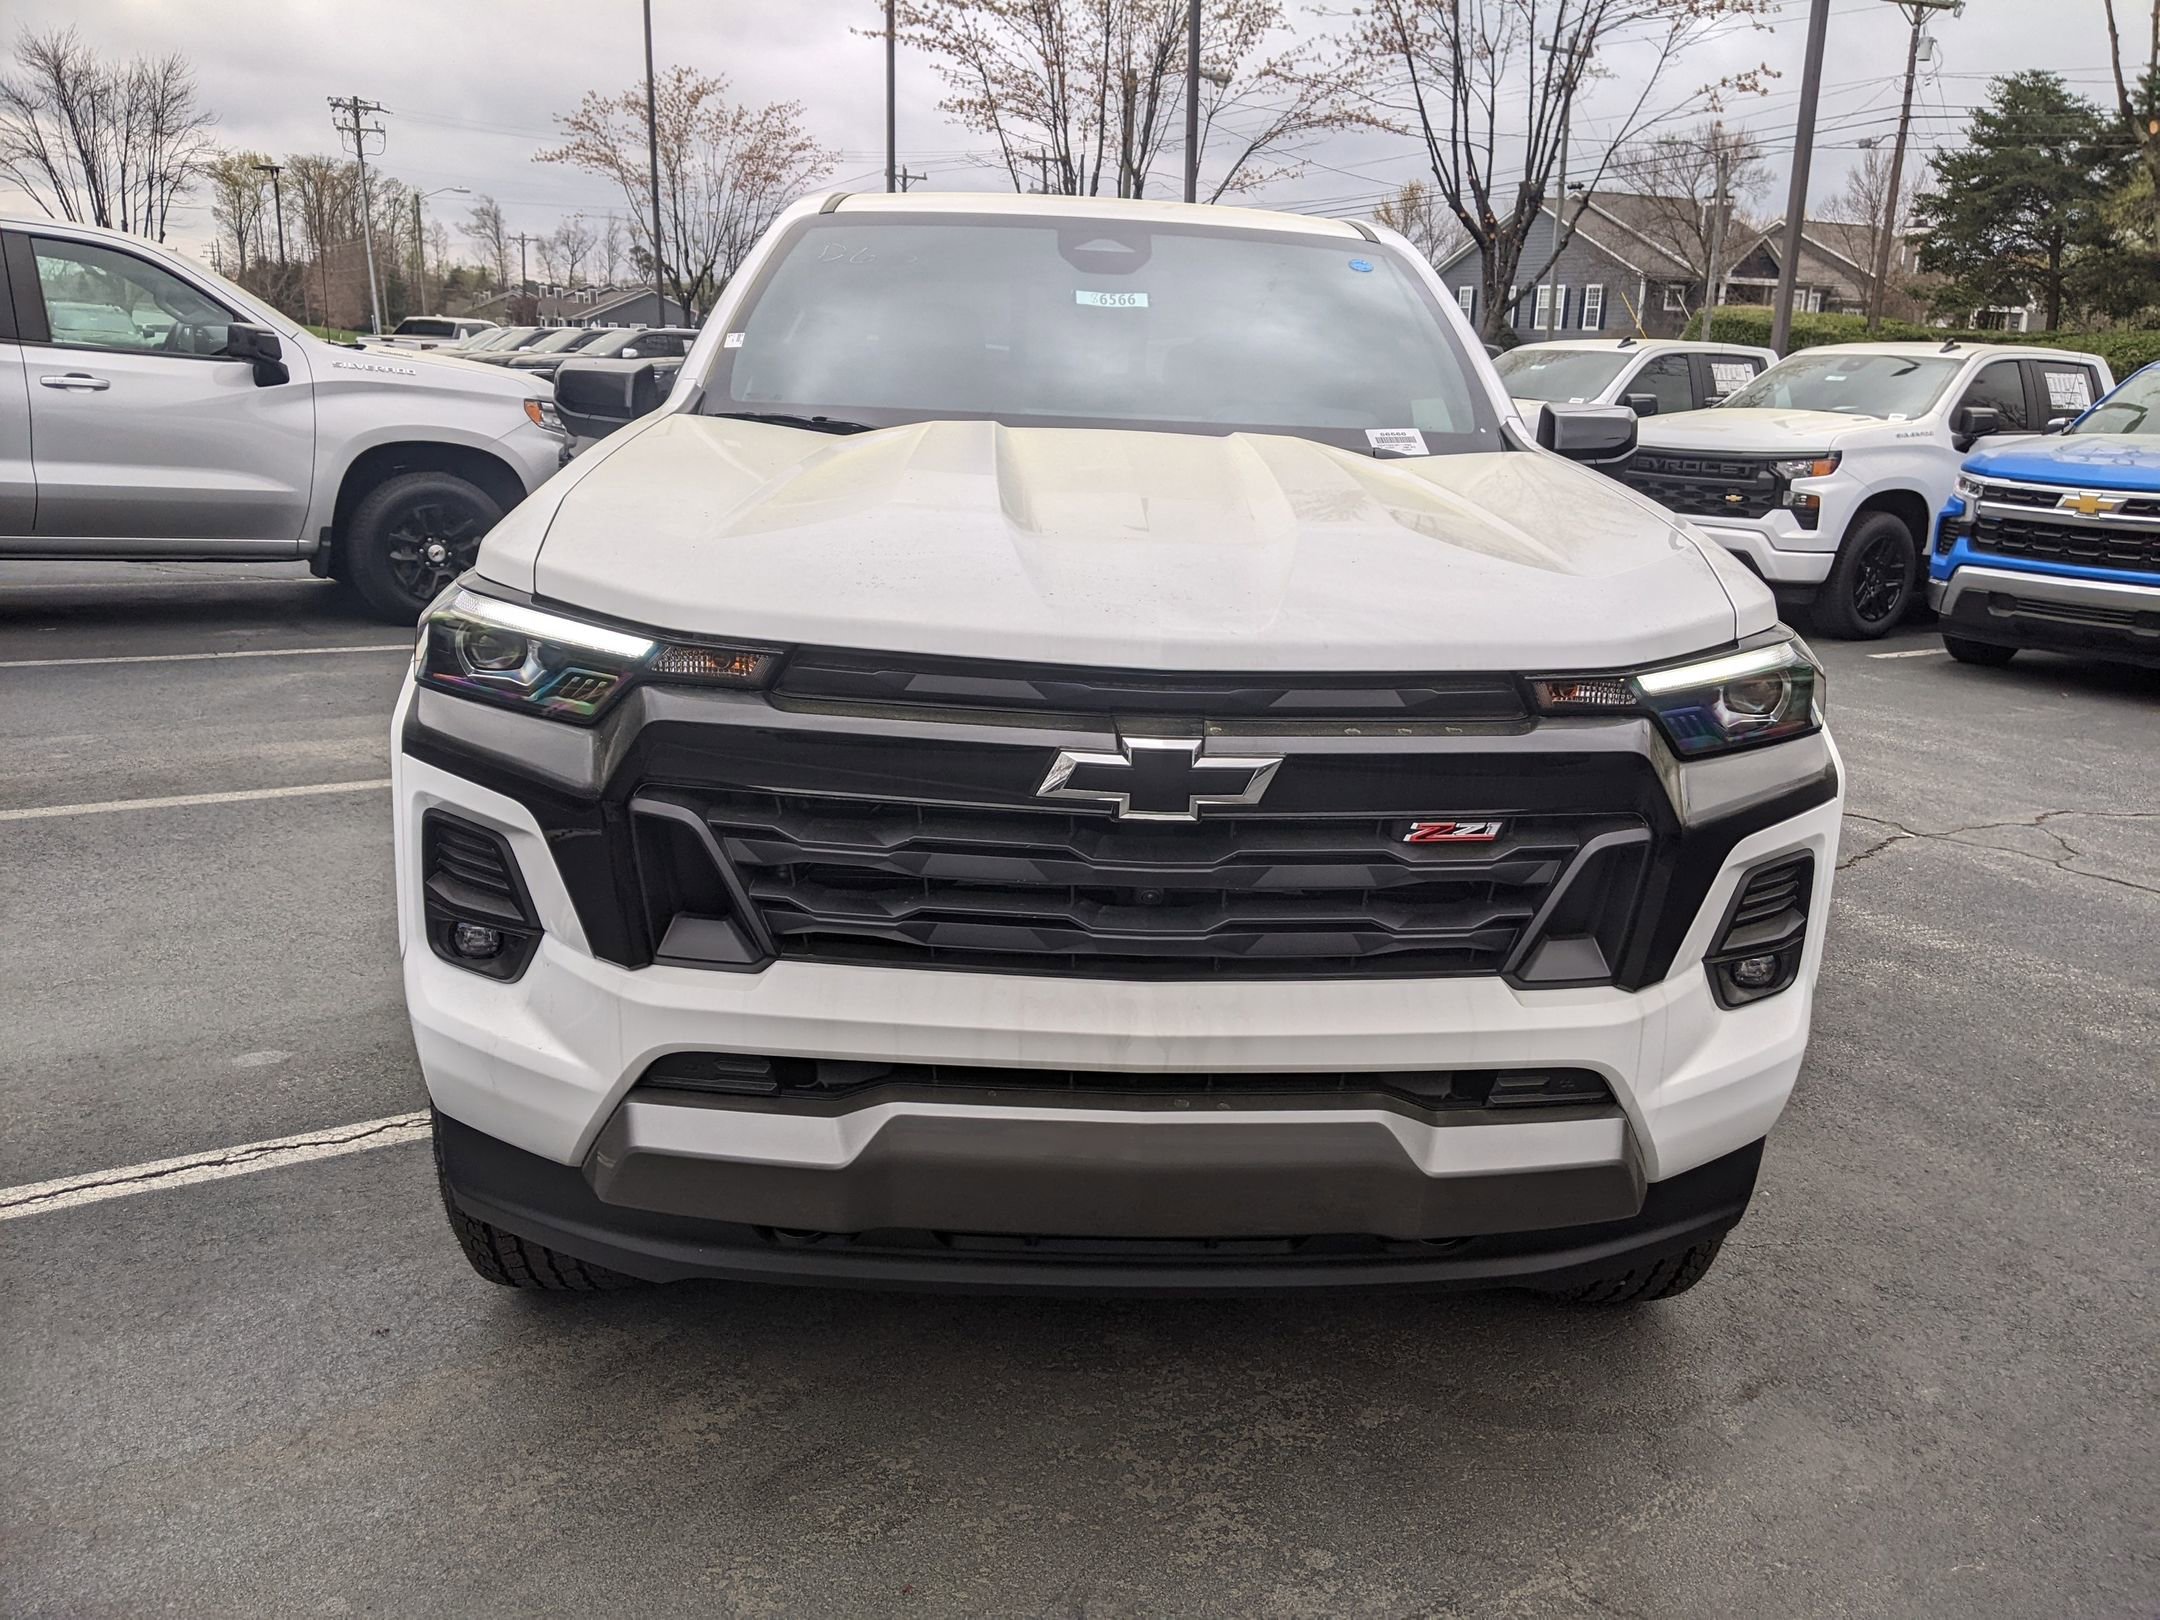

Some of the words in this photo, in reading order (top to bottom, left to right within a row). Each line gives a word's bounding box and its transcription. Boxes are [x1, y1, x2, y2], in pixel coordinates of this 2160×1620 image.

[332, 360, 416, 376] SILVERADO
[1633, 456, 1757, 477] EVROLET
[1404, 821, 1503, 842] Z71
